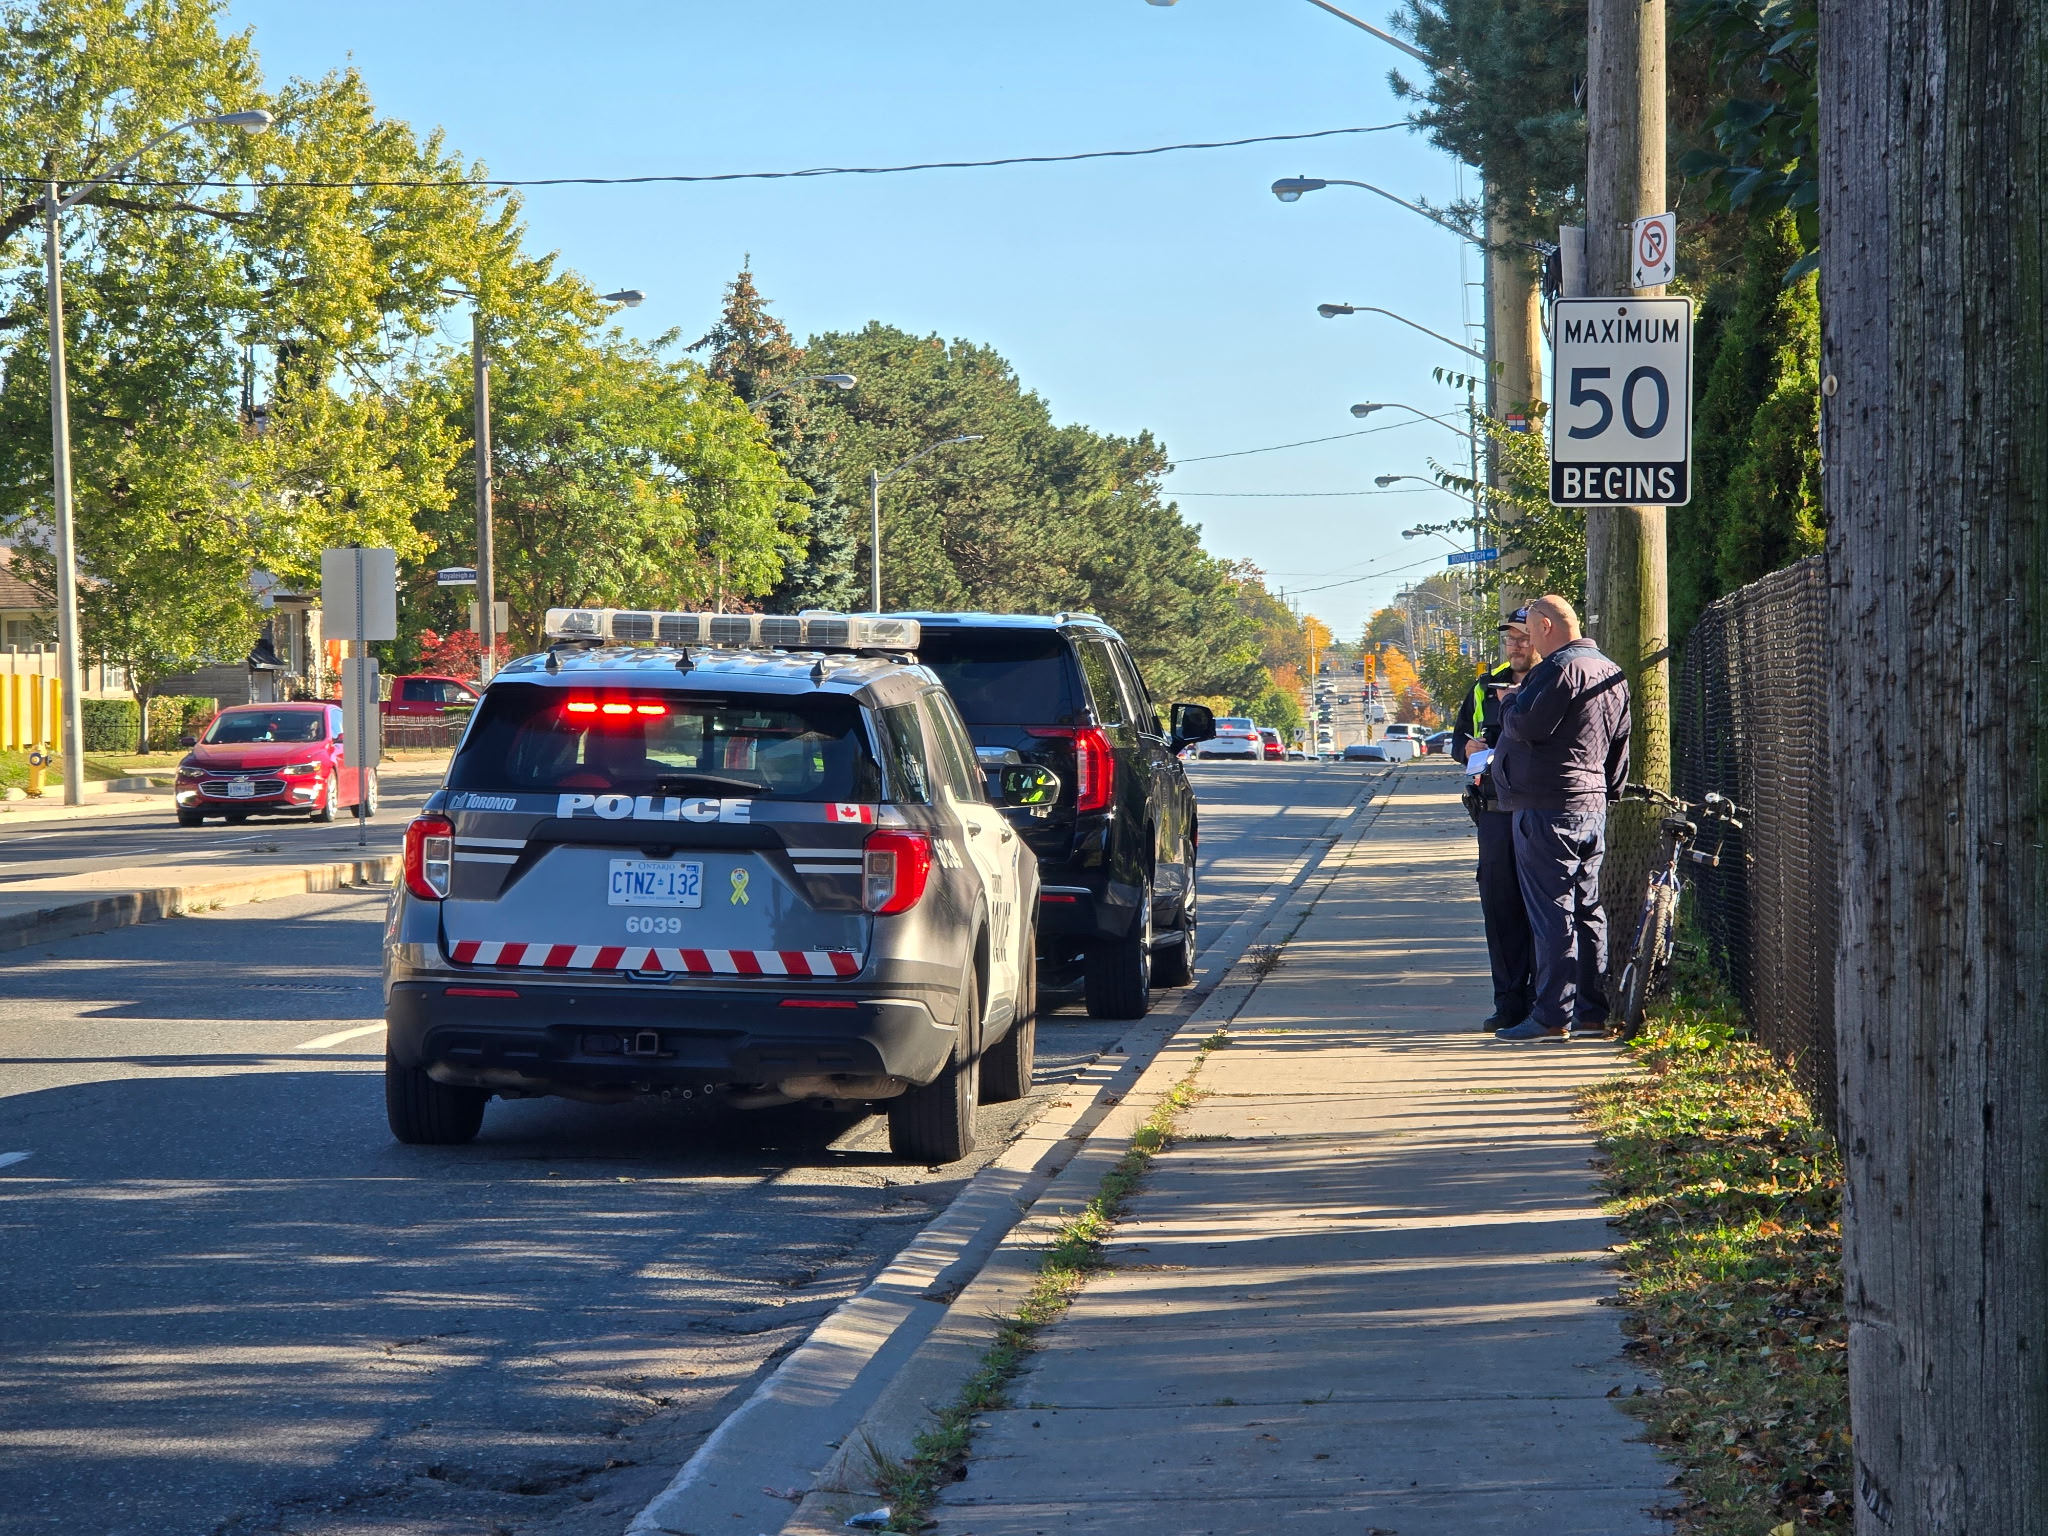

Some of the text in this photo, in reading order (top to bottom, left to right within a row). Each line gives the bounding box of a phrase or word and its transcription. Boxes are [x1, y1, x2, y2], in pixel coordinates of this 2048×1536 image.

[1648, 233, 1662, 258] P
[1565, 319, 1679, 344] MAXIMUM
[1567, 366, 1670, 440] 50
[1563, 467, 1675, 500] BEGINS
[465, 793, 517, 811] TORONTO
[556, 793, 752, 824] POLICE
[612, 871, 699, 896] CTNZ 132
[626, 916, 682, 934] 6039
